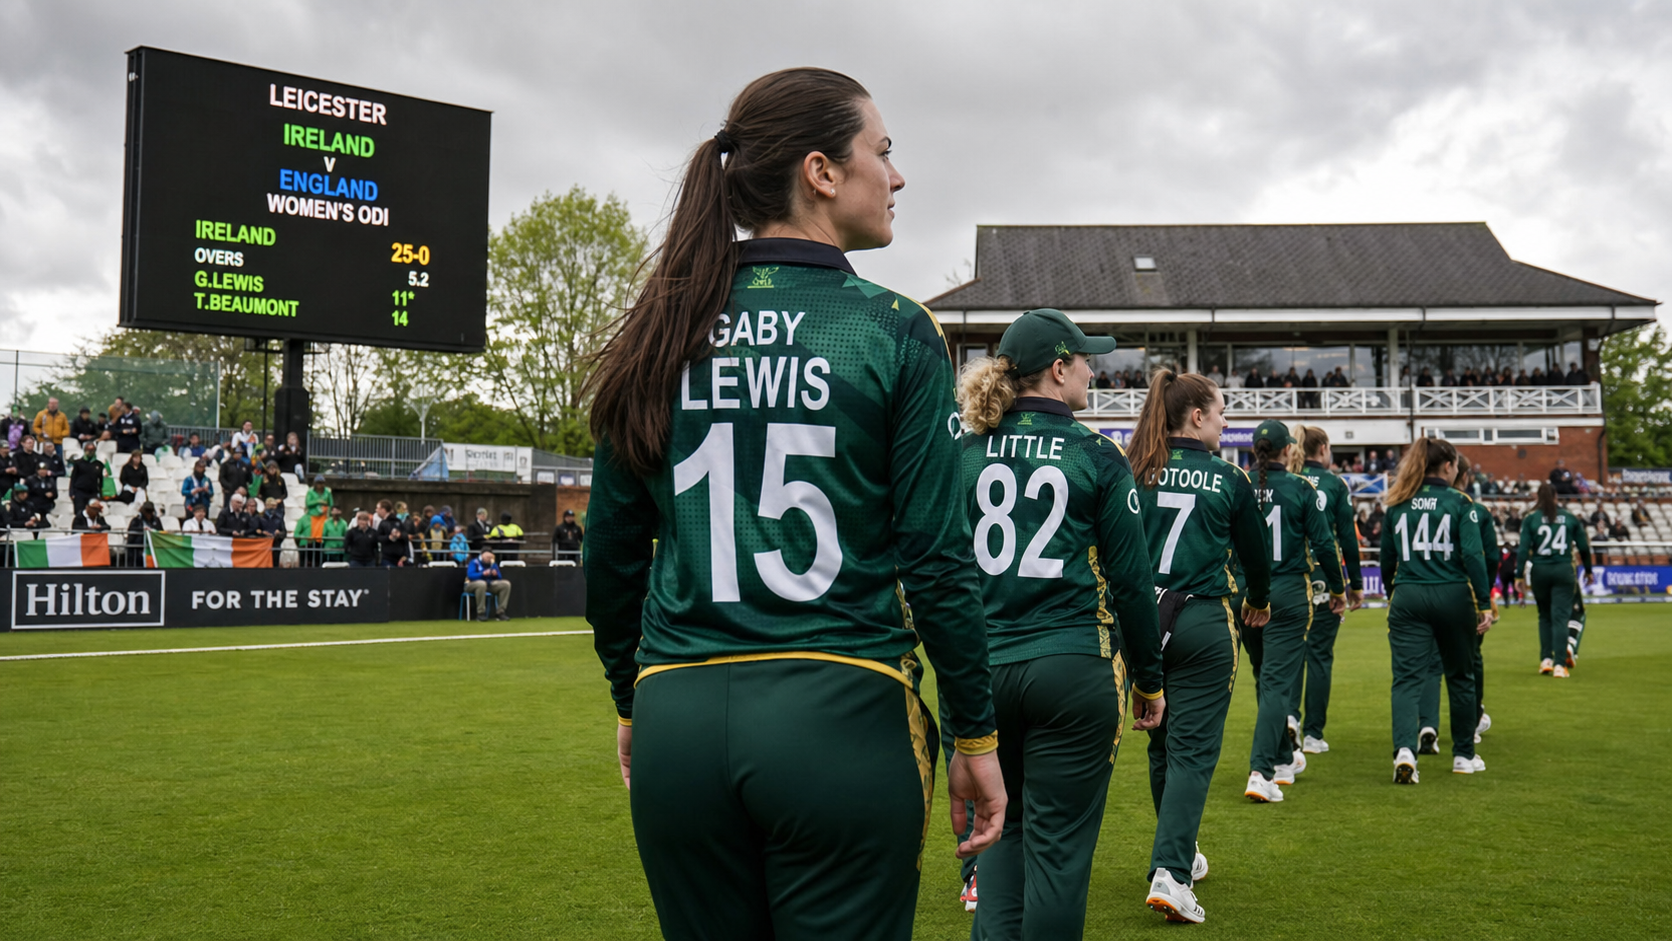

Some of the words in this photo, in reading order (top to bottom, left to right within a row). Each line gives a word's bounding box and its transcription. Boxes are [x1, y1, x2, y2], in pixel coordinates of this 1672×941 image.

[269, 83, 388, 126] LEICESTER
[283, 123, 376, 158] IRELAND
[279, 168, 379, 202] ENGLAND
[266, 192, 354, 223] WOMEN'S
[358, 204, 389, 227] ODI
[195, 219, 276, 246] IRELAND
[391, 242, 431, 266] 25-0
[194, 247, 244, 267] OVERS
[408, 270, 430, 288] 5.2
[194, 270, 264, 293] G.LEWIS
[194, 292, 299, 318] T.BEAUMONT
[391, 309, 409, 327] 14
[708, 310, 806, 348] GABY
[681, 356, 831, 411] LEWIS
[985, 434, 1065, 461] LITTLE
[673, 422, 843, 603] 15
[973, 463, 1069, 579] 82
[1156, 491, 1197, 575] 7
[1394, 512, 1454, 562] 144
[1538, 524, 1568, 556] 24
[25, 583, 151, 616] Hilton
[191, 590, 241, 610] FOR
[250, 590, 298, 609] THE
